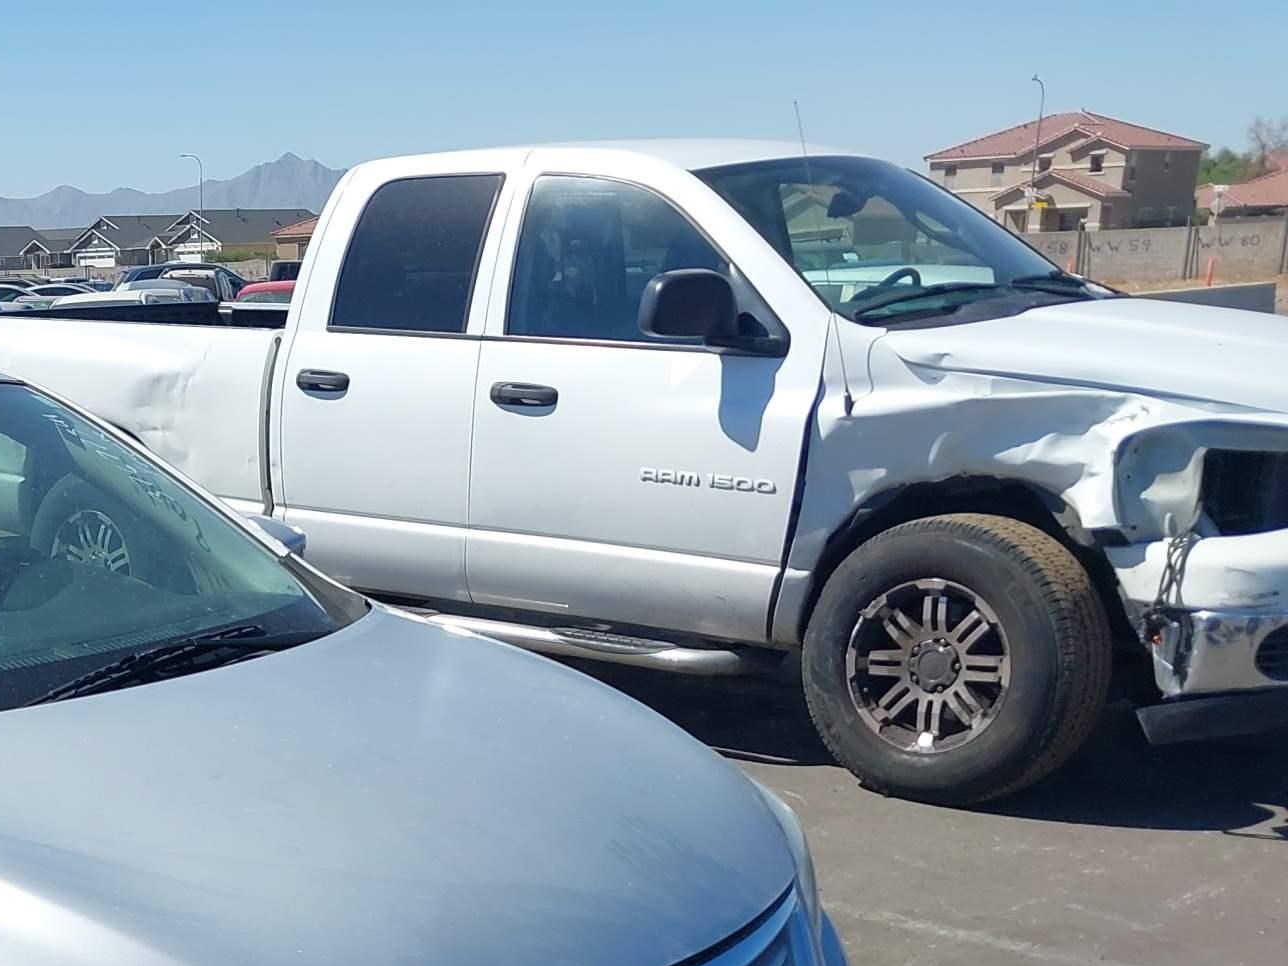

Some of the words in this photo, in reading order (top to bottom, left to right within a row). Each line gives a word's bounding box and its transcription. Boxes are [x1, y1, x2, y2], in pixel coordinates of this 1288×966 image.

[1128, 238, 1152, 252] 59
[1240, 233, 1262, 248] 60
[640, 466, 701, 488] RAM
[706, 472, 777, 495] 1500
